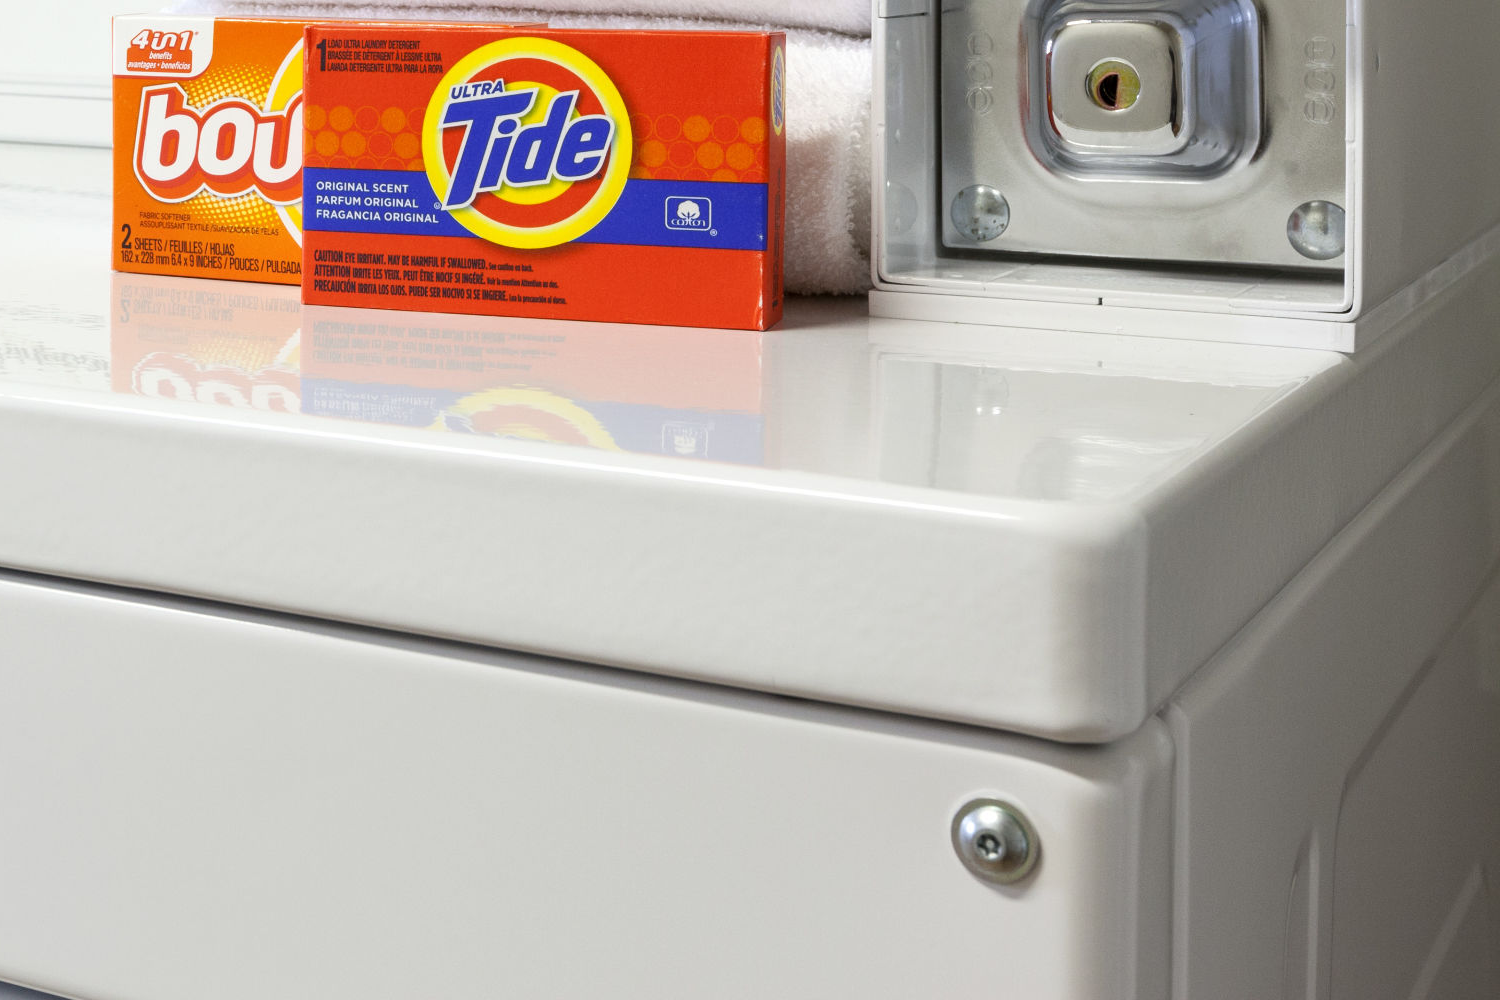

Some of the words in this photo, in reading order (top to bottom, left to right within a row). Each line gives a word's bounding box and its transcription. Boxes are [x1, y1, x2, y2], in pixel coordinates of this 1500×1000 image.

[327, 39, 342, 49] LOAD
[343, 40, 360, 49] ULTRA
[361, 40, 387, 50] LAUNDRY
[388, 40, 420, 50] DETERGENT
[149, 51, 172, 60] benefits
[316, 39, 326, 72] 1
[354, 51, 361, 61] DE
[362, 50, 394, 61] DÉTERGENT
[401, 52, 422, 62] LESSIVE
[424, 52, 442, 62] ULTRA
[128, 61, 156, 70] avantages
[161, 61, 191, 70] beneficios
[327, 63, 348, 73] LAVADA
[349, 63, 384, 73] DETERGENTE
[385, 64, 402, 73] ULTRA
[404, 64, 418, 74] PARA
[419, 64, 426, 74] LA
[428, 64, 443, 74] ROPA
[450, 80, 504, 99] ULTRA
[138, 86, 303, 195] bou
[439, 88, 615, 209] Tide
[316, 181, 370, 192] ORIGINAL
[373, 183, 409, 193] SCENT
[316, 195, 361, 206] PARFUM
[364, 197, 419, 208] ORIGINAL
[140, 211, 160, 220] FABRIC
[161, 213, 191, 221] SOFTENER
[316, 209, 381, 221] FRAGANCIA
[384, 212, 439, 223] ORIGINAL
[121, 223, 132, 249] 2
[140, 220, 185, 230] ASSOUPLISSANT
[187, 223, 210, 232] TEXTILE
[252, 227, 260, 235] DE
[261, 227, 279, 236] TELAS
[134, 237, 163, 251] SHEETS
[169, 239, 203, 254] FEUILLES
[210, 242, 235, 256] HOJAS
[121, 250, 133, 263] 162
[141, 251, 154, 264] 228
[155, 255, 170, 265] mm
[171, 253, 182, 266] 6.4
[190, 254, 195, 267] 9
[196, 254, 222, 269] INCHES
[229, 257, 260, 272] POUCES
[266, 260, 301, 274] PULGADA
[314, 250, 343, 262] CAUTION
[345, 252, 355, 263] EYE
[357, 253, 386, 265] IRRITANT.
[387, 254, 401, 265] MAY
[402, 255, 409, 266] BE
[411, 256, 439, 267] HARMFUL
[441, 257, 446, 267] IF
[448, 257, 488, 270] SWALLOWED.
[314, 265, 350, 277] ATTENTION
[353, 268, 371, 279] IRRITE
[373, 268, 383, 279] LES
[384, 269, 401, 281] YEUX.
[403, 270, 418, 281] PEUT
[420, 269, 434, 282] ÊTRE
[435, 272, 453, 283] NOCIF
[455, 272, 461, 283] SI
[314, 279, 356, 293] PRECAUCIÓN
[358, 283, 377, 295] IRRITA
[379, 284, 389, 295] LOS
[391, 284, 407, 296] OJOS.
[409, 286, 428, 297] PUEDE
[430, 287, 440, 298] SER
[442, 287, 465, 299] NOCIVO
[466, 289, 472, 299] SI
[474, 289, 481, 300] SE
[482, 289, 508, 301] INGIERE.
